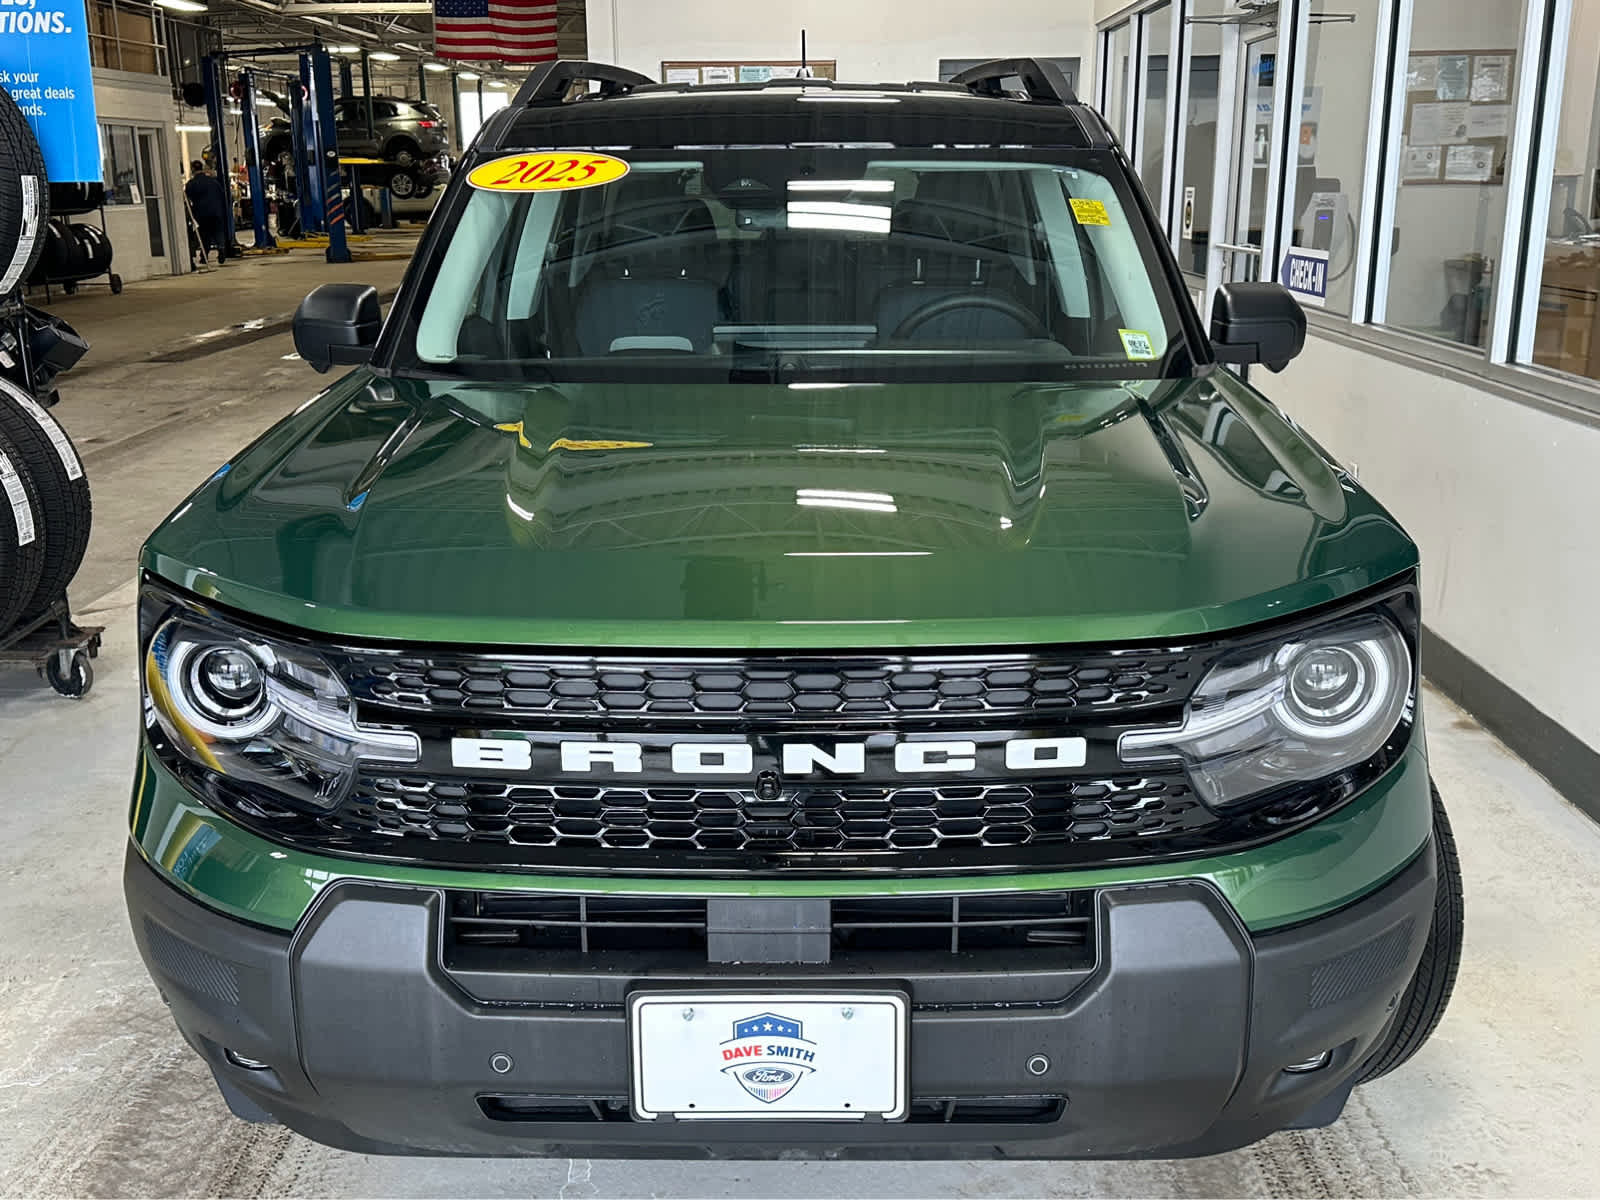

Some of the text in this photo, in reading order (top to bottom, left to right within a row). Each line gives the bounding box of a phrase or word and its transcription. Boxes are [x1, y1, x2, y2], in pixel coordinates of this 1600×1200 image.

[13, 72, 39, 85] your
[11, 86, 75, 101] great deals
[18, 103, 47, 116] nds.
[490, 159, 608, 185] 2025
[451, 736, 1087, 774] BRONCO
[722, 1045, 815, 1062] DAVE SMITH
[752, 1069, 785, 1082] Ford
